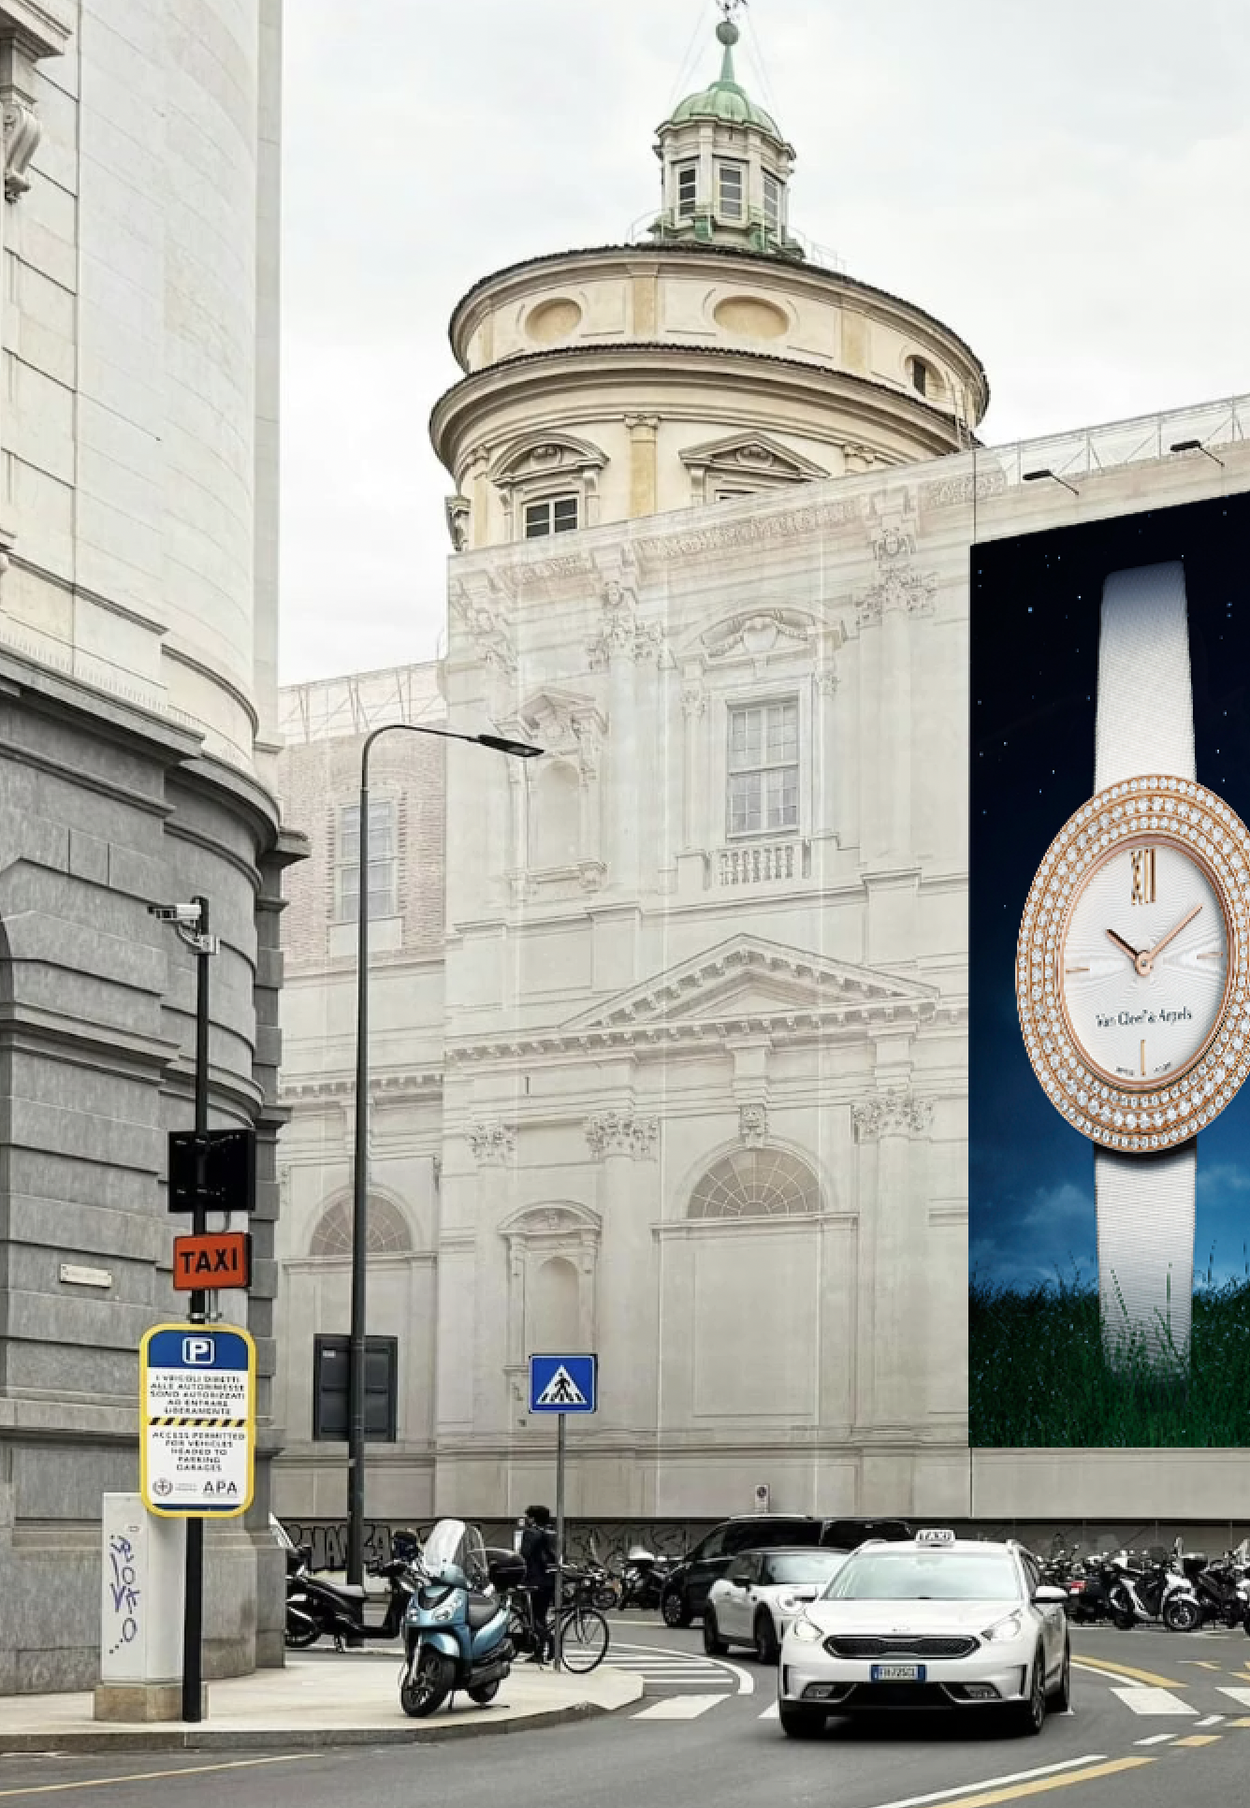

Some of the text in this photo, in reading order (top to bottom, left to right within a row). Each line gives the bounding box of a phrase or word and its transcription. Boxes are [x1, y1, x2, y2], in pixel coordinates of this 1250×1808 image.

[178, 1247, 239, 1274] TAXI
[189, 1341, 209, 1362] P
[151, 1382, 245, 1392] ALLE AUTORIMESSE
[150, 1390, 244, 1400] SONO AUTORIZZATI
[184, 1399, 228, 1407] ENTRARE
[164, 1407, 231, 1415] LIBERAMENTE
[192, 1432, 245, 1441] PERMITTED
[188, 1440, 233, 1448] VEHICLES
[170, 1448, 228, 1456] HEADED TO
[176, 1464, 222, 1472] GARAGES
[203, 1480, 238, 1494] APA
